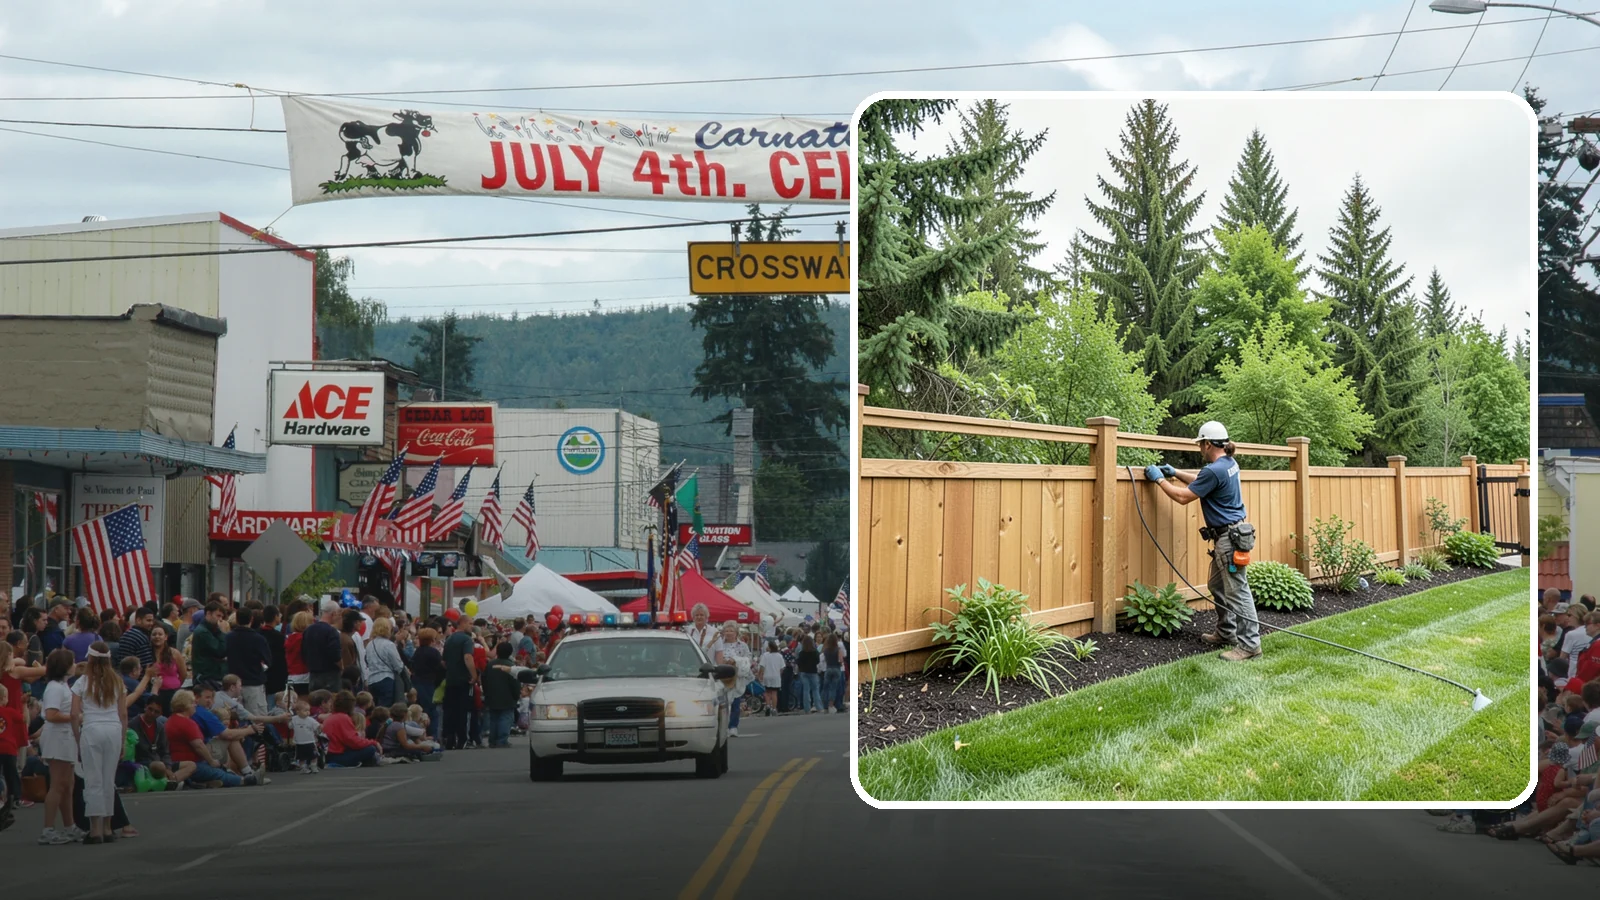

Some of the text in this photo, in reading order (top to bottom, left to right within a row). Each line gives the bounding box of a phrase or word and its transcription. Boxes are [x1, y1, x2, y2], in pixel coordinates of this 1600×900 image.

[695, 121, 850, 149] Carnat
[481, 141, 604, 192] JULY
[632, 150, 746, 198] 4th.
[697, 254, 850, 280] CROSSWA
[283, 380, 374, 420] ACE
[405, 409, 485, 421] CEDAR LOG
[283, 421, 371, 436] Hardware
[416, 428, 477, 447] Coca-Cola
[354, 467, 386, 480] Simpl
[83, 485, 155, 495] St. Vincent de Paul
[80, 503, 153, 522] THT
[212, 516, 330, 535] HARDARE
[688, 526, 741, 535] CRNATION
[699, 535, 730, 543] GLASS
